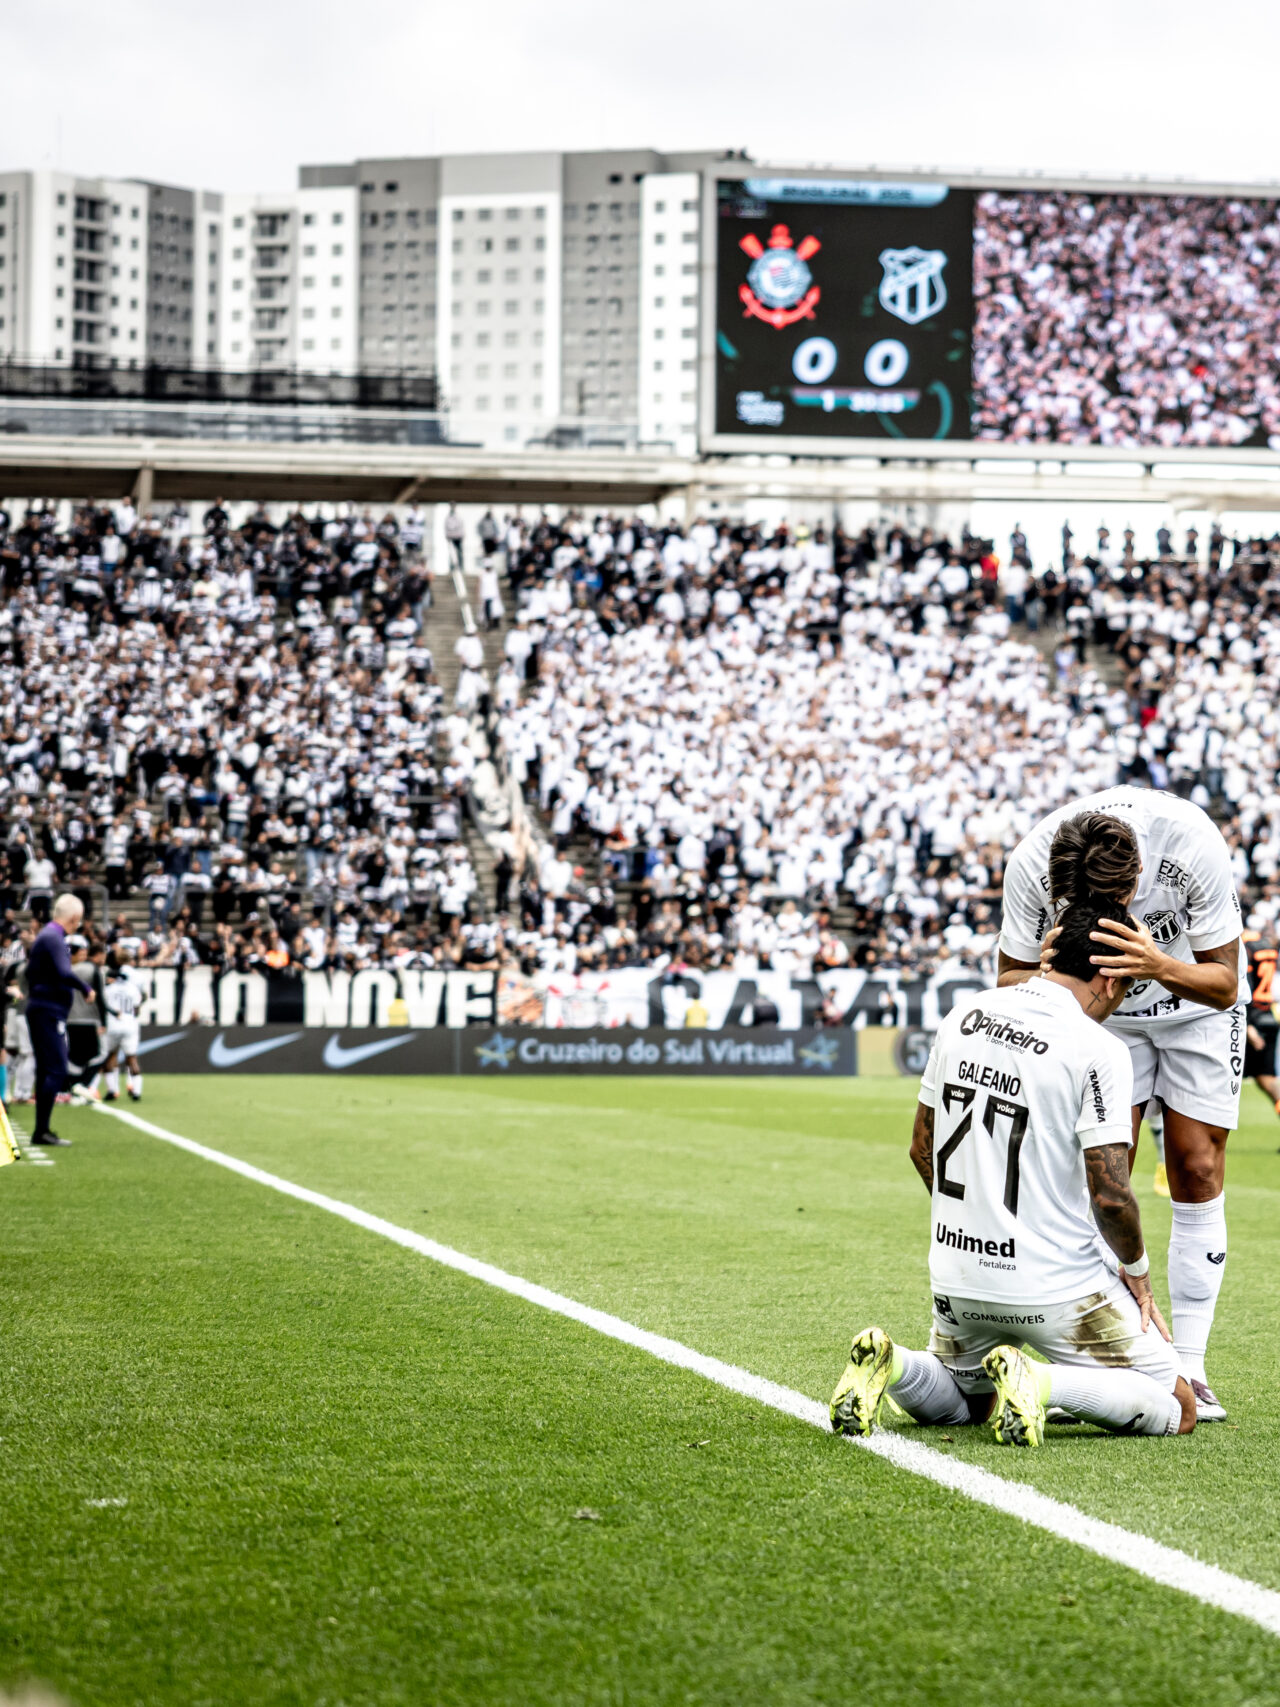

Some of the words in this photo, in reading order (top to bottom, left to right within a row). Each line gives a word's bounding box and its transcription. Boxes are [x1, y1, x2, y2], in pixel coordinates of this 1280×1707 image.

[791, 336, 838, 385] 0
[863, 338, 909, 387] 0
[519, 1038, 622, 1064] Cruzeiro
[626, 1037, 660, 1062] do
[663, 1038, 703, 1064] Sul
[707, 1038, 795, 1065] Virtual
[975, 1016, 1049, 1055] Pinheiro
[958, 1060, 1021, 1096] GALEANO
[996, 1101, 1016, 1115] voke
[936, 1082, 1029, 1219] 27
[936, 1222, 1015, 1258] Unimed
[978, 1259, 1017, 1271] Fortaleza
[962, 1311, 1045, 1325] COMBUSTÍVEIS
